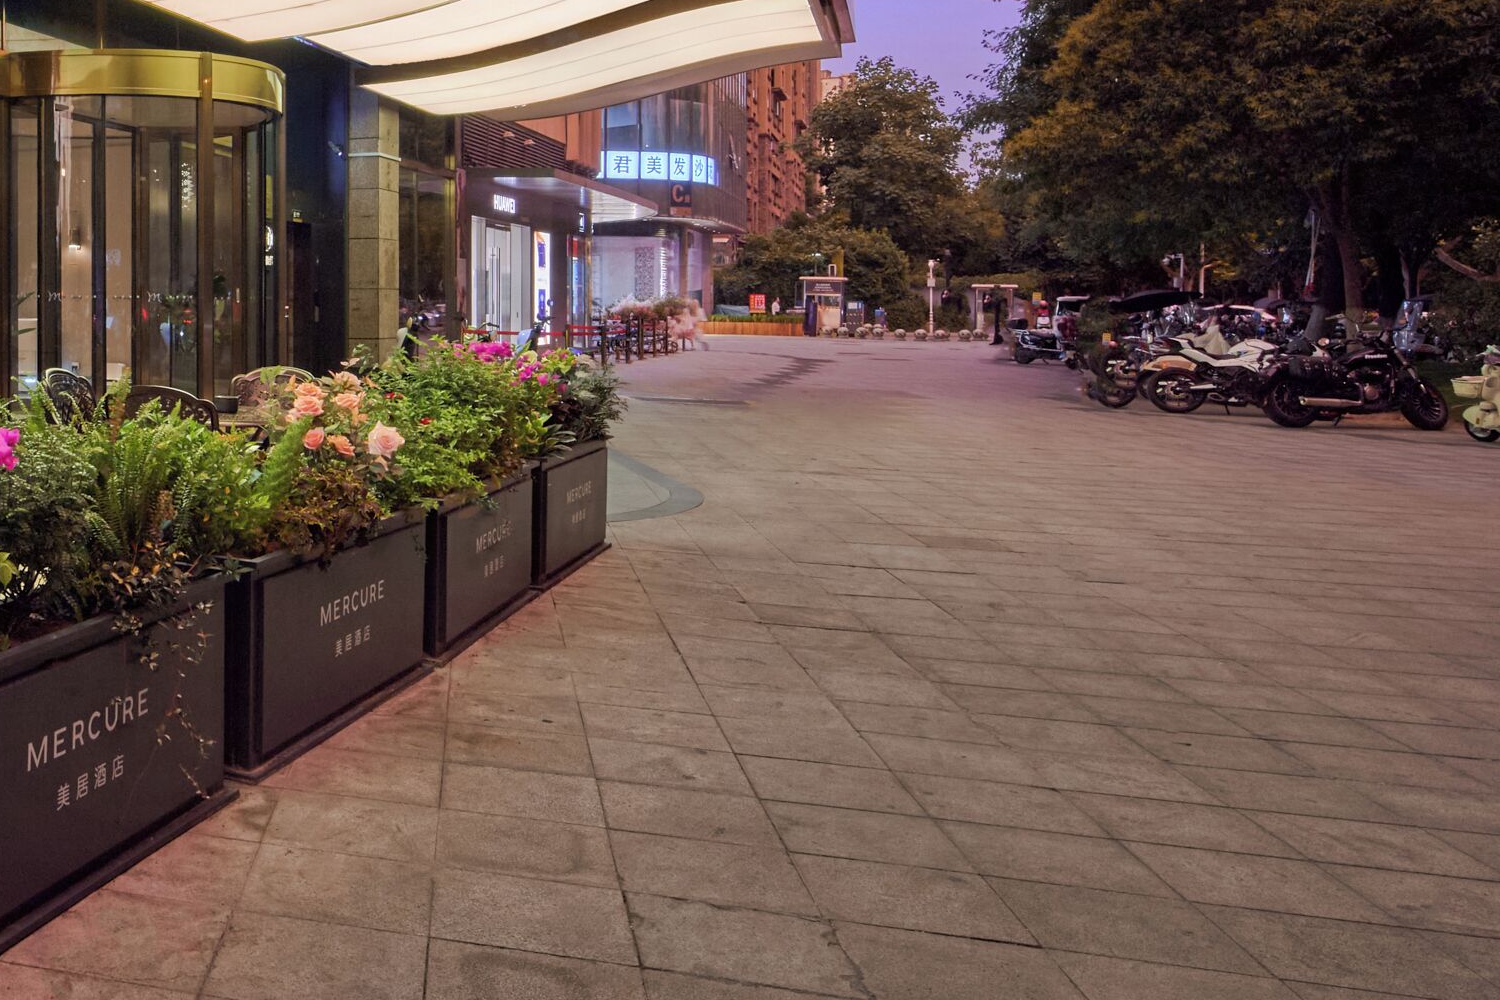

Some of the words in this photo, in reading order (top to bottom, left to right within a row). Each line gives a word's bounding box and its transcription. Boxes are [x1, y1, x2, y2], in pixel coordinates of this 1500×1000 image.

[493, 194, 516, 214] HUAWEI
[320, 579, 386, 626] MERCURE
[334, 624, 371, 658] 美居酒店
[27, 687, 150, 772] MERCURE
[55, 753, 125, 811] 美居酒店
